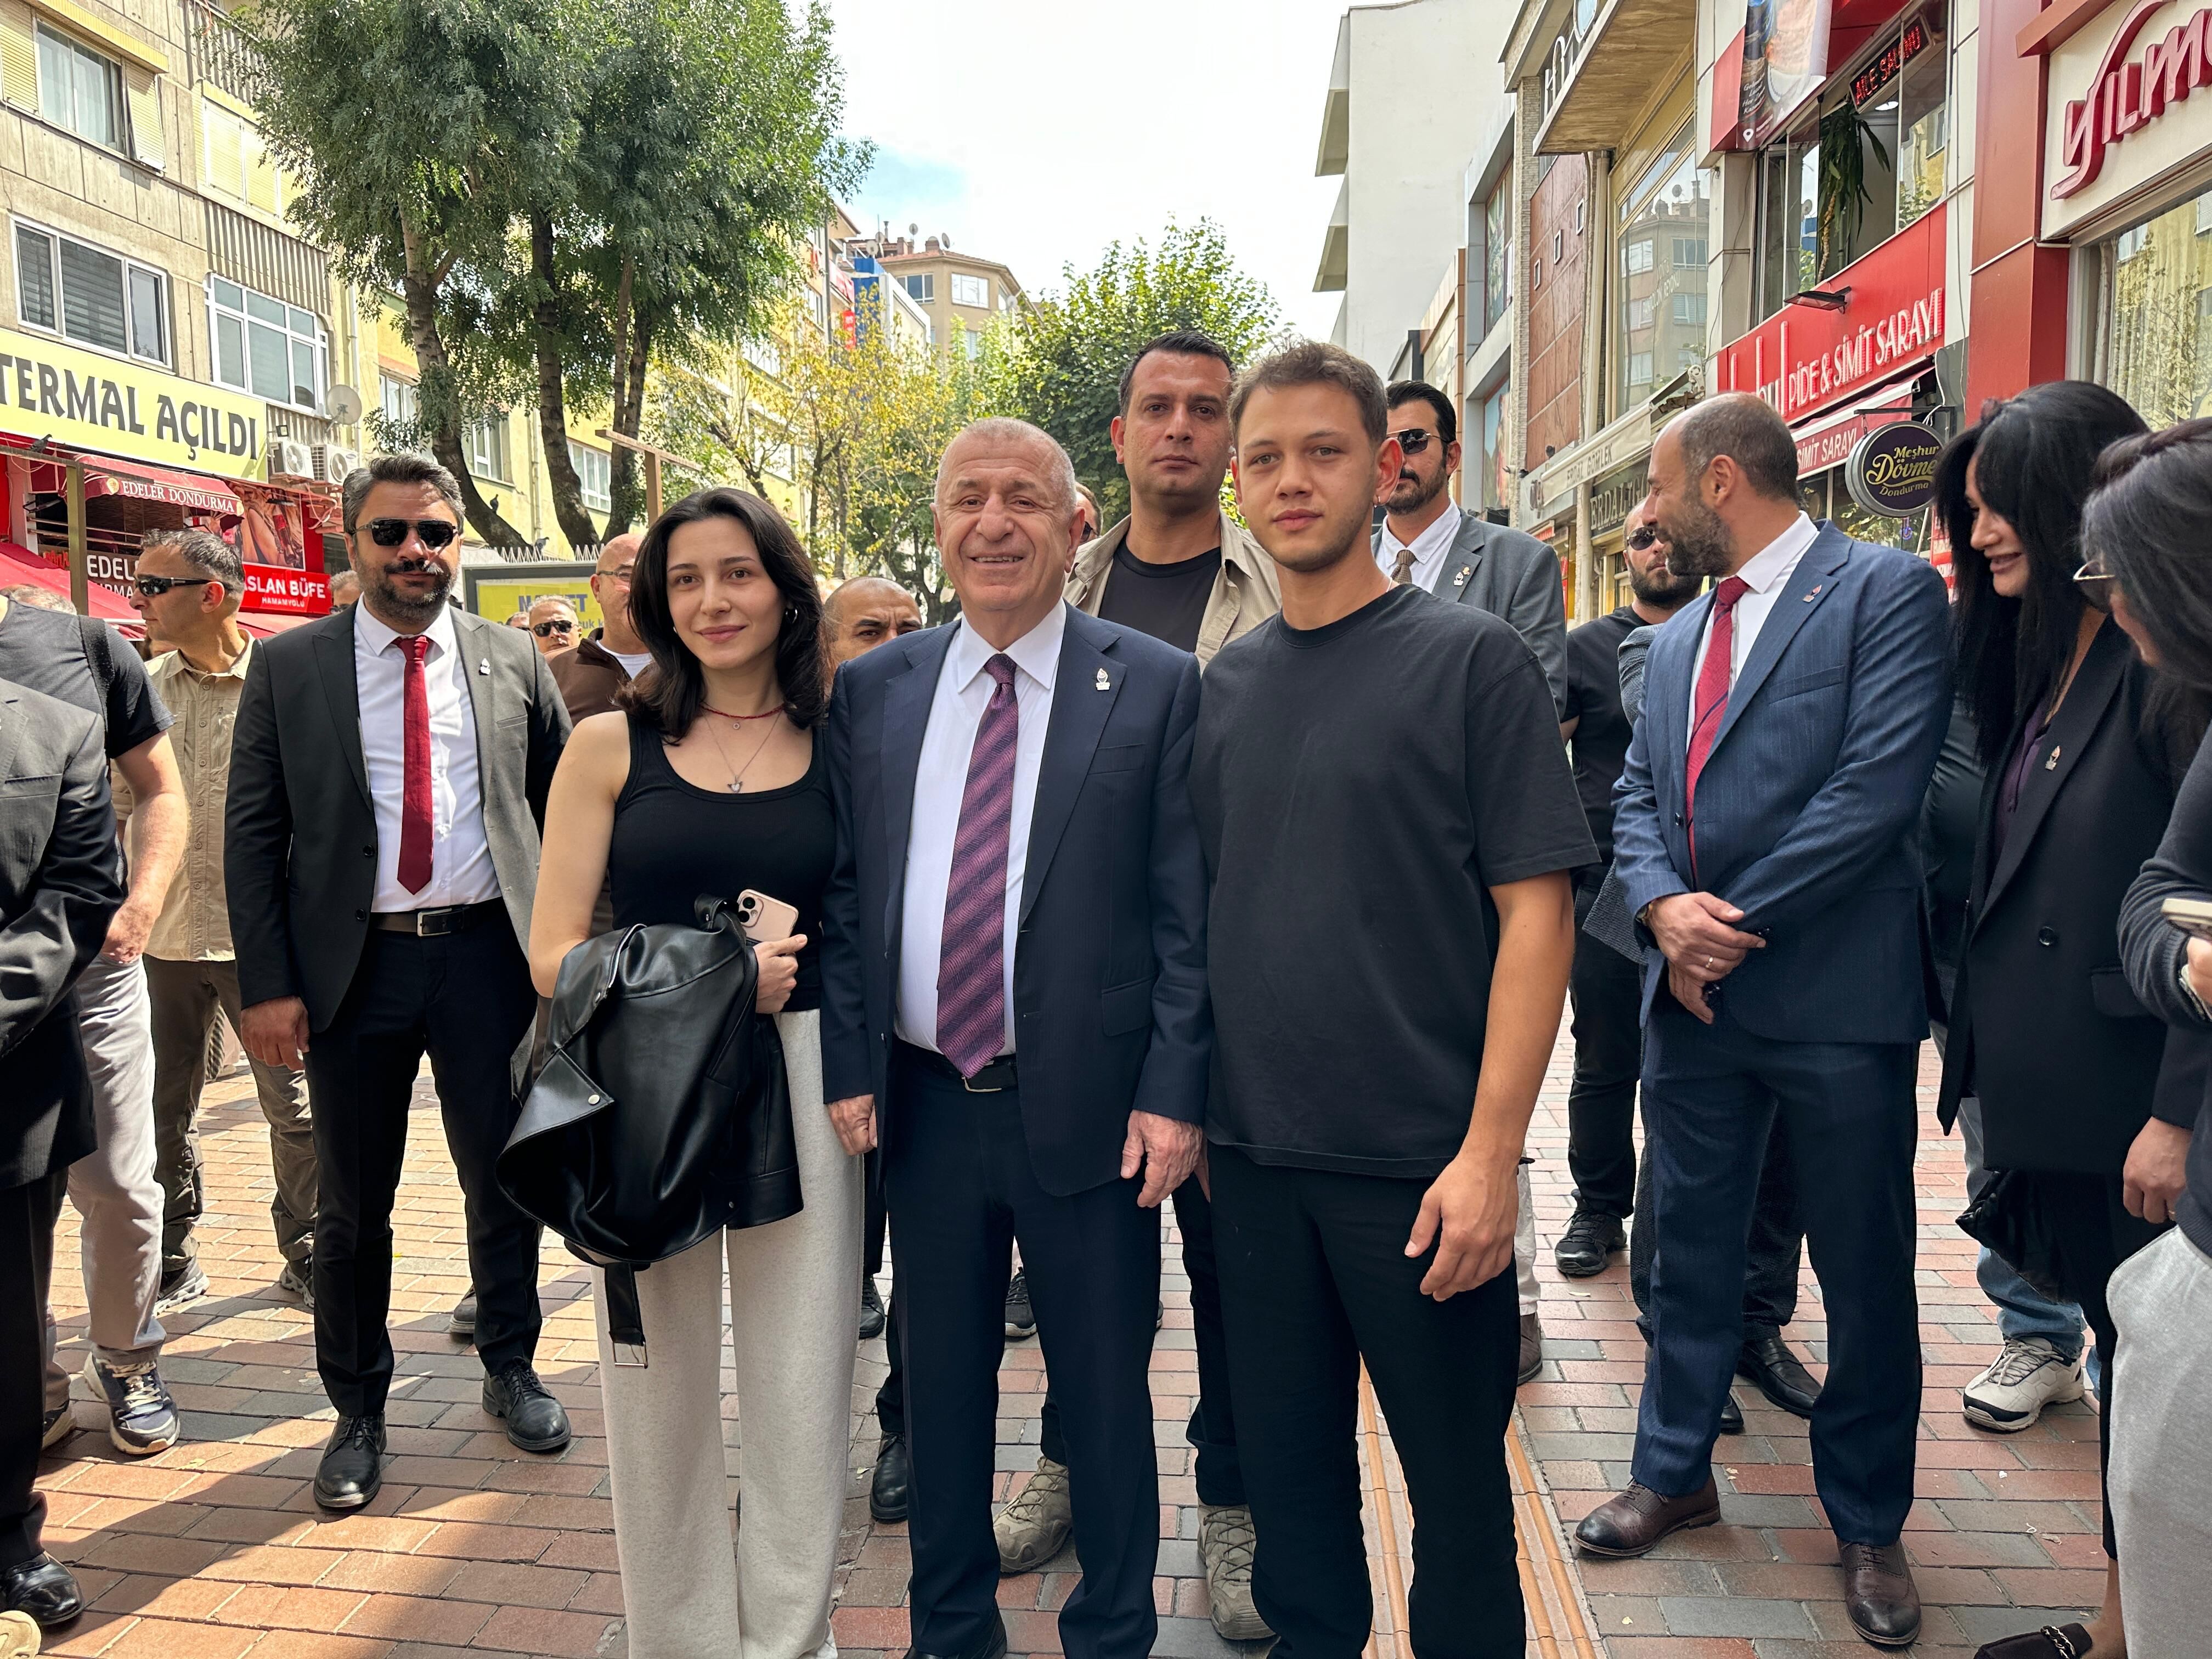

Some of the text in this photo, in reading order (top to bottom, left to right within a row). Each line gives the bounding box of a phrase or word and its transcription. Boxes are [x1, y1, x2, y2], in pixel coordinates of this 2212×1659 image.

[1788, 359, 1819, 411] PİDE
[1820, 352, 1833, 394] &
[1833, 324, 1876, 388] SİMİT
[1875, 287, 1943, 366] SARAYI
[156, 394, 257, 461] AÇILDI
[1821, 427, 1857, 462] SARAYI
[1893, 445, 1939, 460] Meşhur
[122, 481, 235, 513] EDELER DONDURMA
[1879, 482, 1929, 496] Dondurma
[1590, 483, 1626, 531] ERDAL
[87, 555, 139, 581] EDEL
[262, 596, 306, 608] HAMAMYOLU
[290, 578, 326, 599] BÜFE
